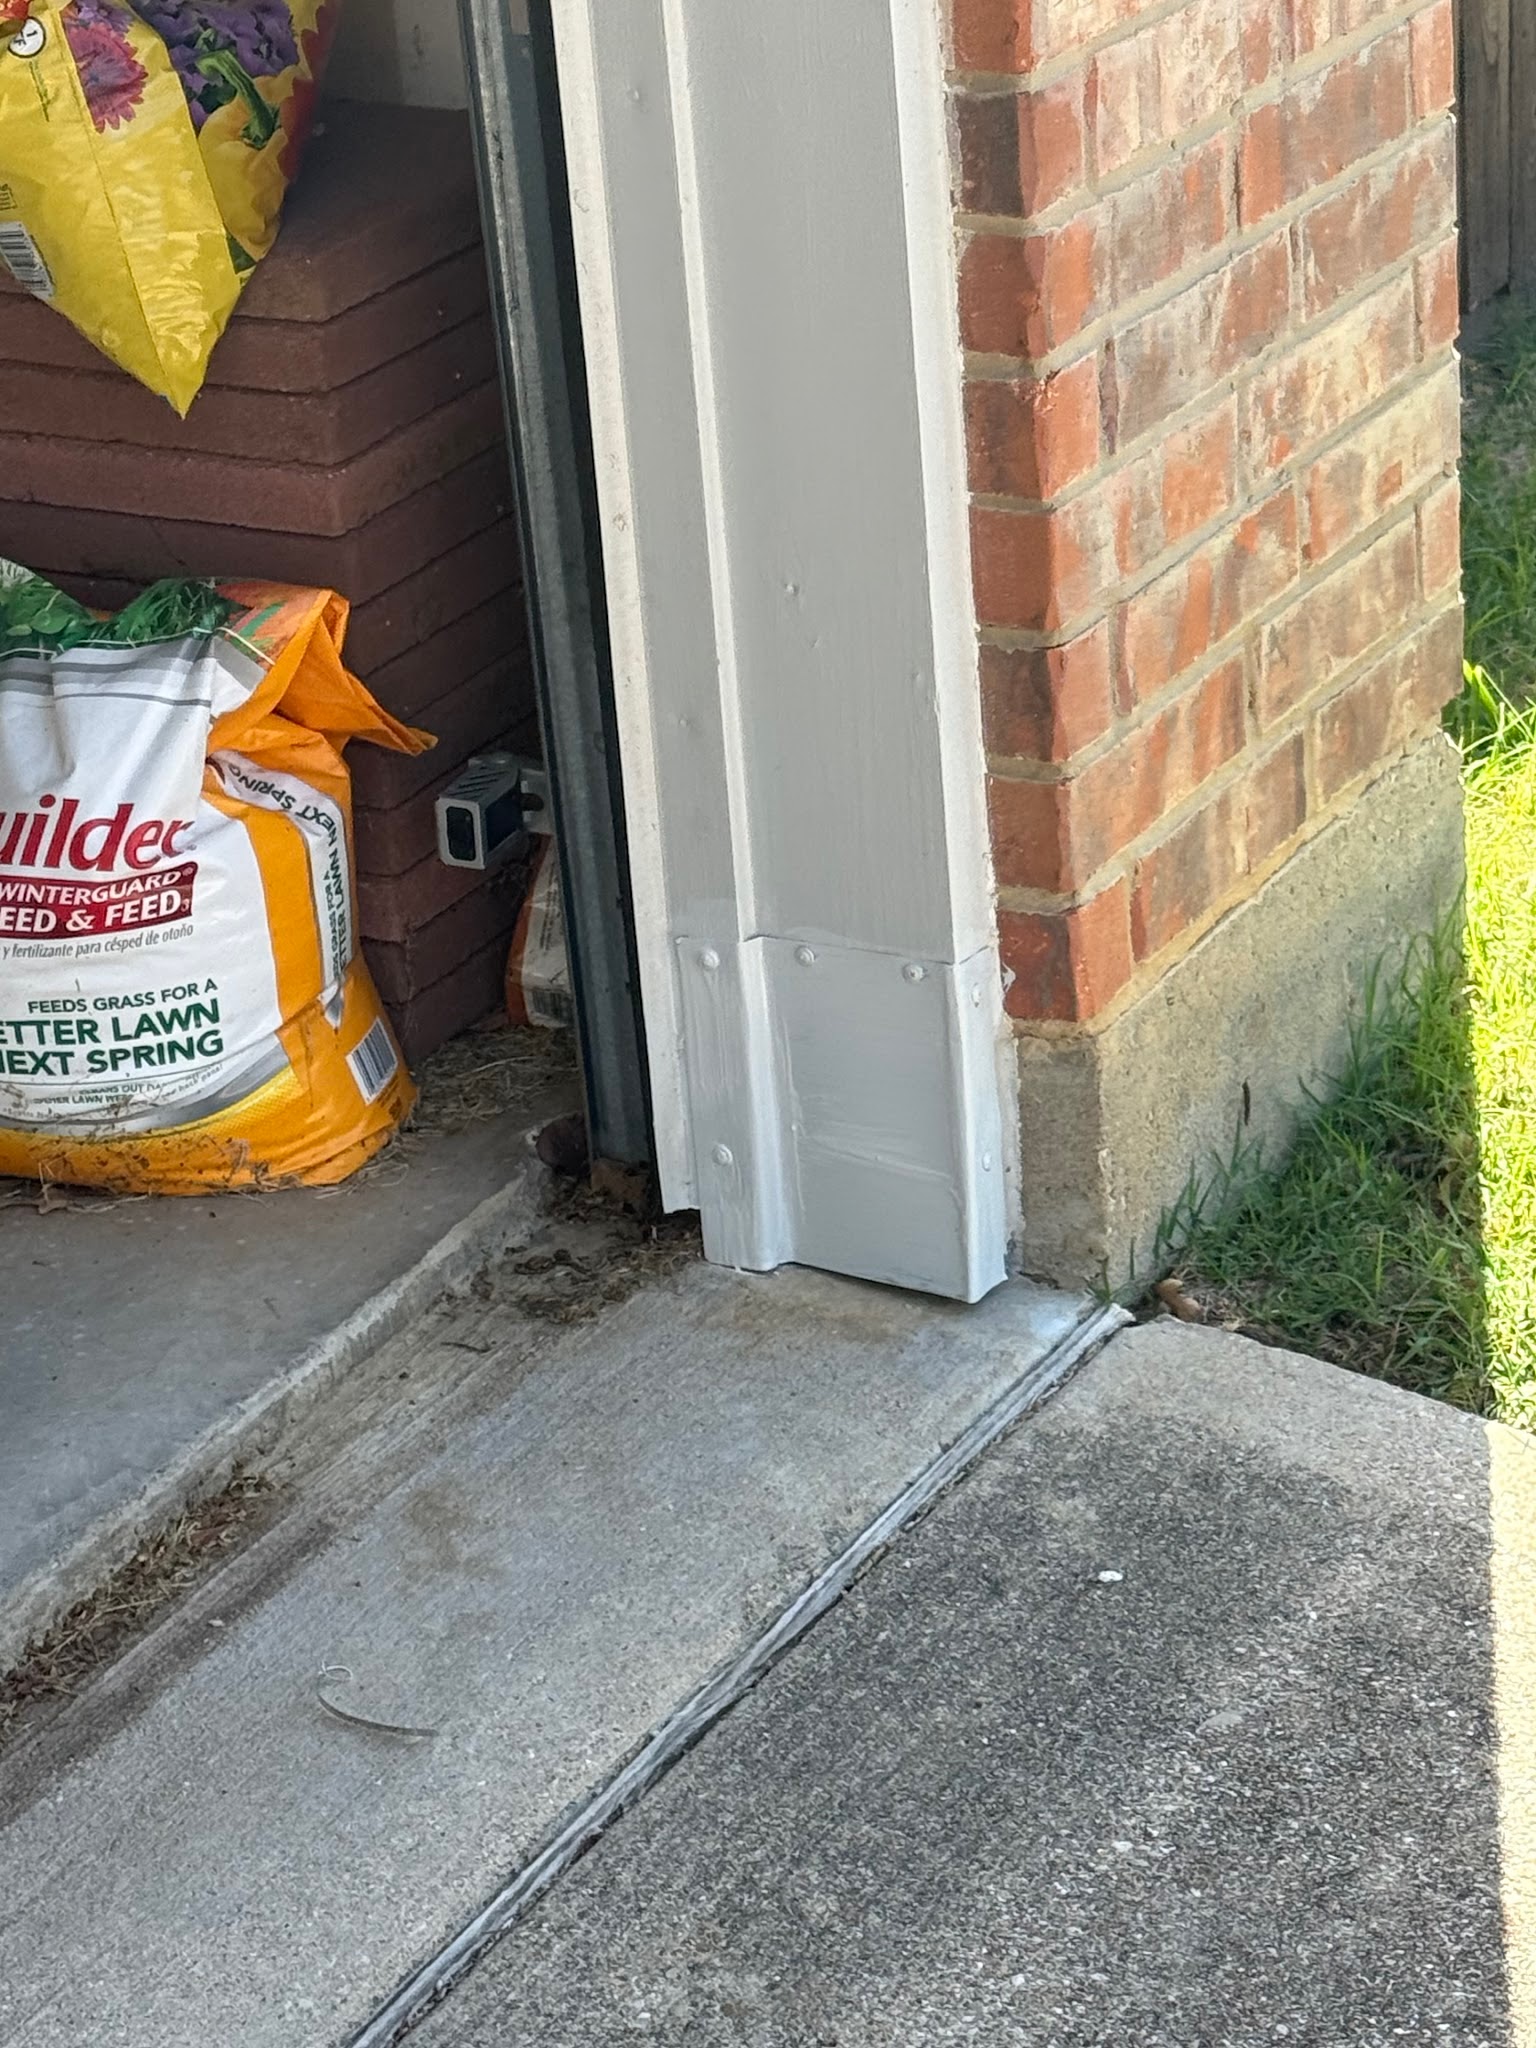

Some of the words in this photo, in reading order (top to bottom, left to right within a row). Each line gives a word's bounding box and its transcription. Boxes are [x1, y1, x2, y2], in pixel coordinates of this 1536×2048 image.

[228, 762, 297, 810] SPRING
[295, 804, 339, 847] NEXT
[328, 848, 346, 909] LAWN
[3, 946, 10, 960] y
[12, 942, 73, 958] fertilizante
[75, 942, 101, 958] para
[104, 932, 144, 953] césped
[145, 929, 160, 946] de
[162, 923, 194, 942] otoño
[65, 909, 95, 932] &
[28, 999, 87, 1014] FEEDS
[93, 992, 155, 1011] GRASS
[161, 983, 199, 1002] FOR
[204, 978, 218, 993] A
[112, 998, 221, 1042] LAWN
[0, 1050, 75, 1076] EXT
[87, 1029, 224, 1074] SPRING
[72, 1094, 102, 1104] LAWN
